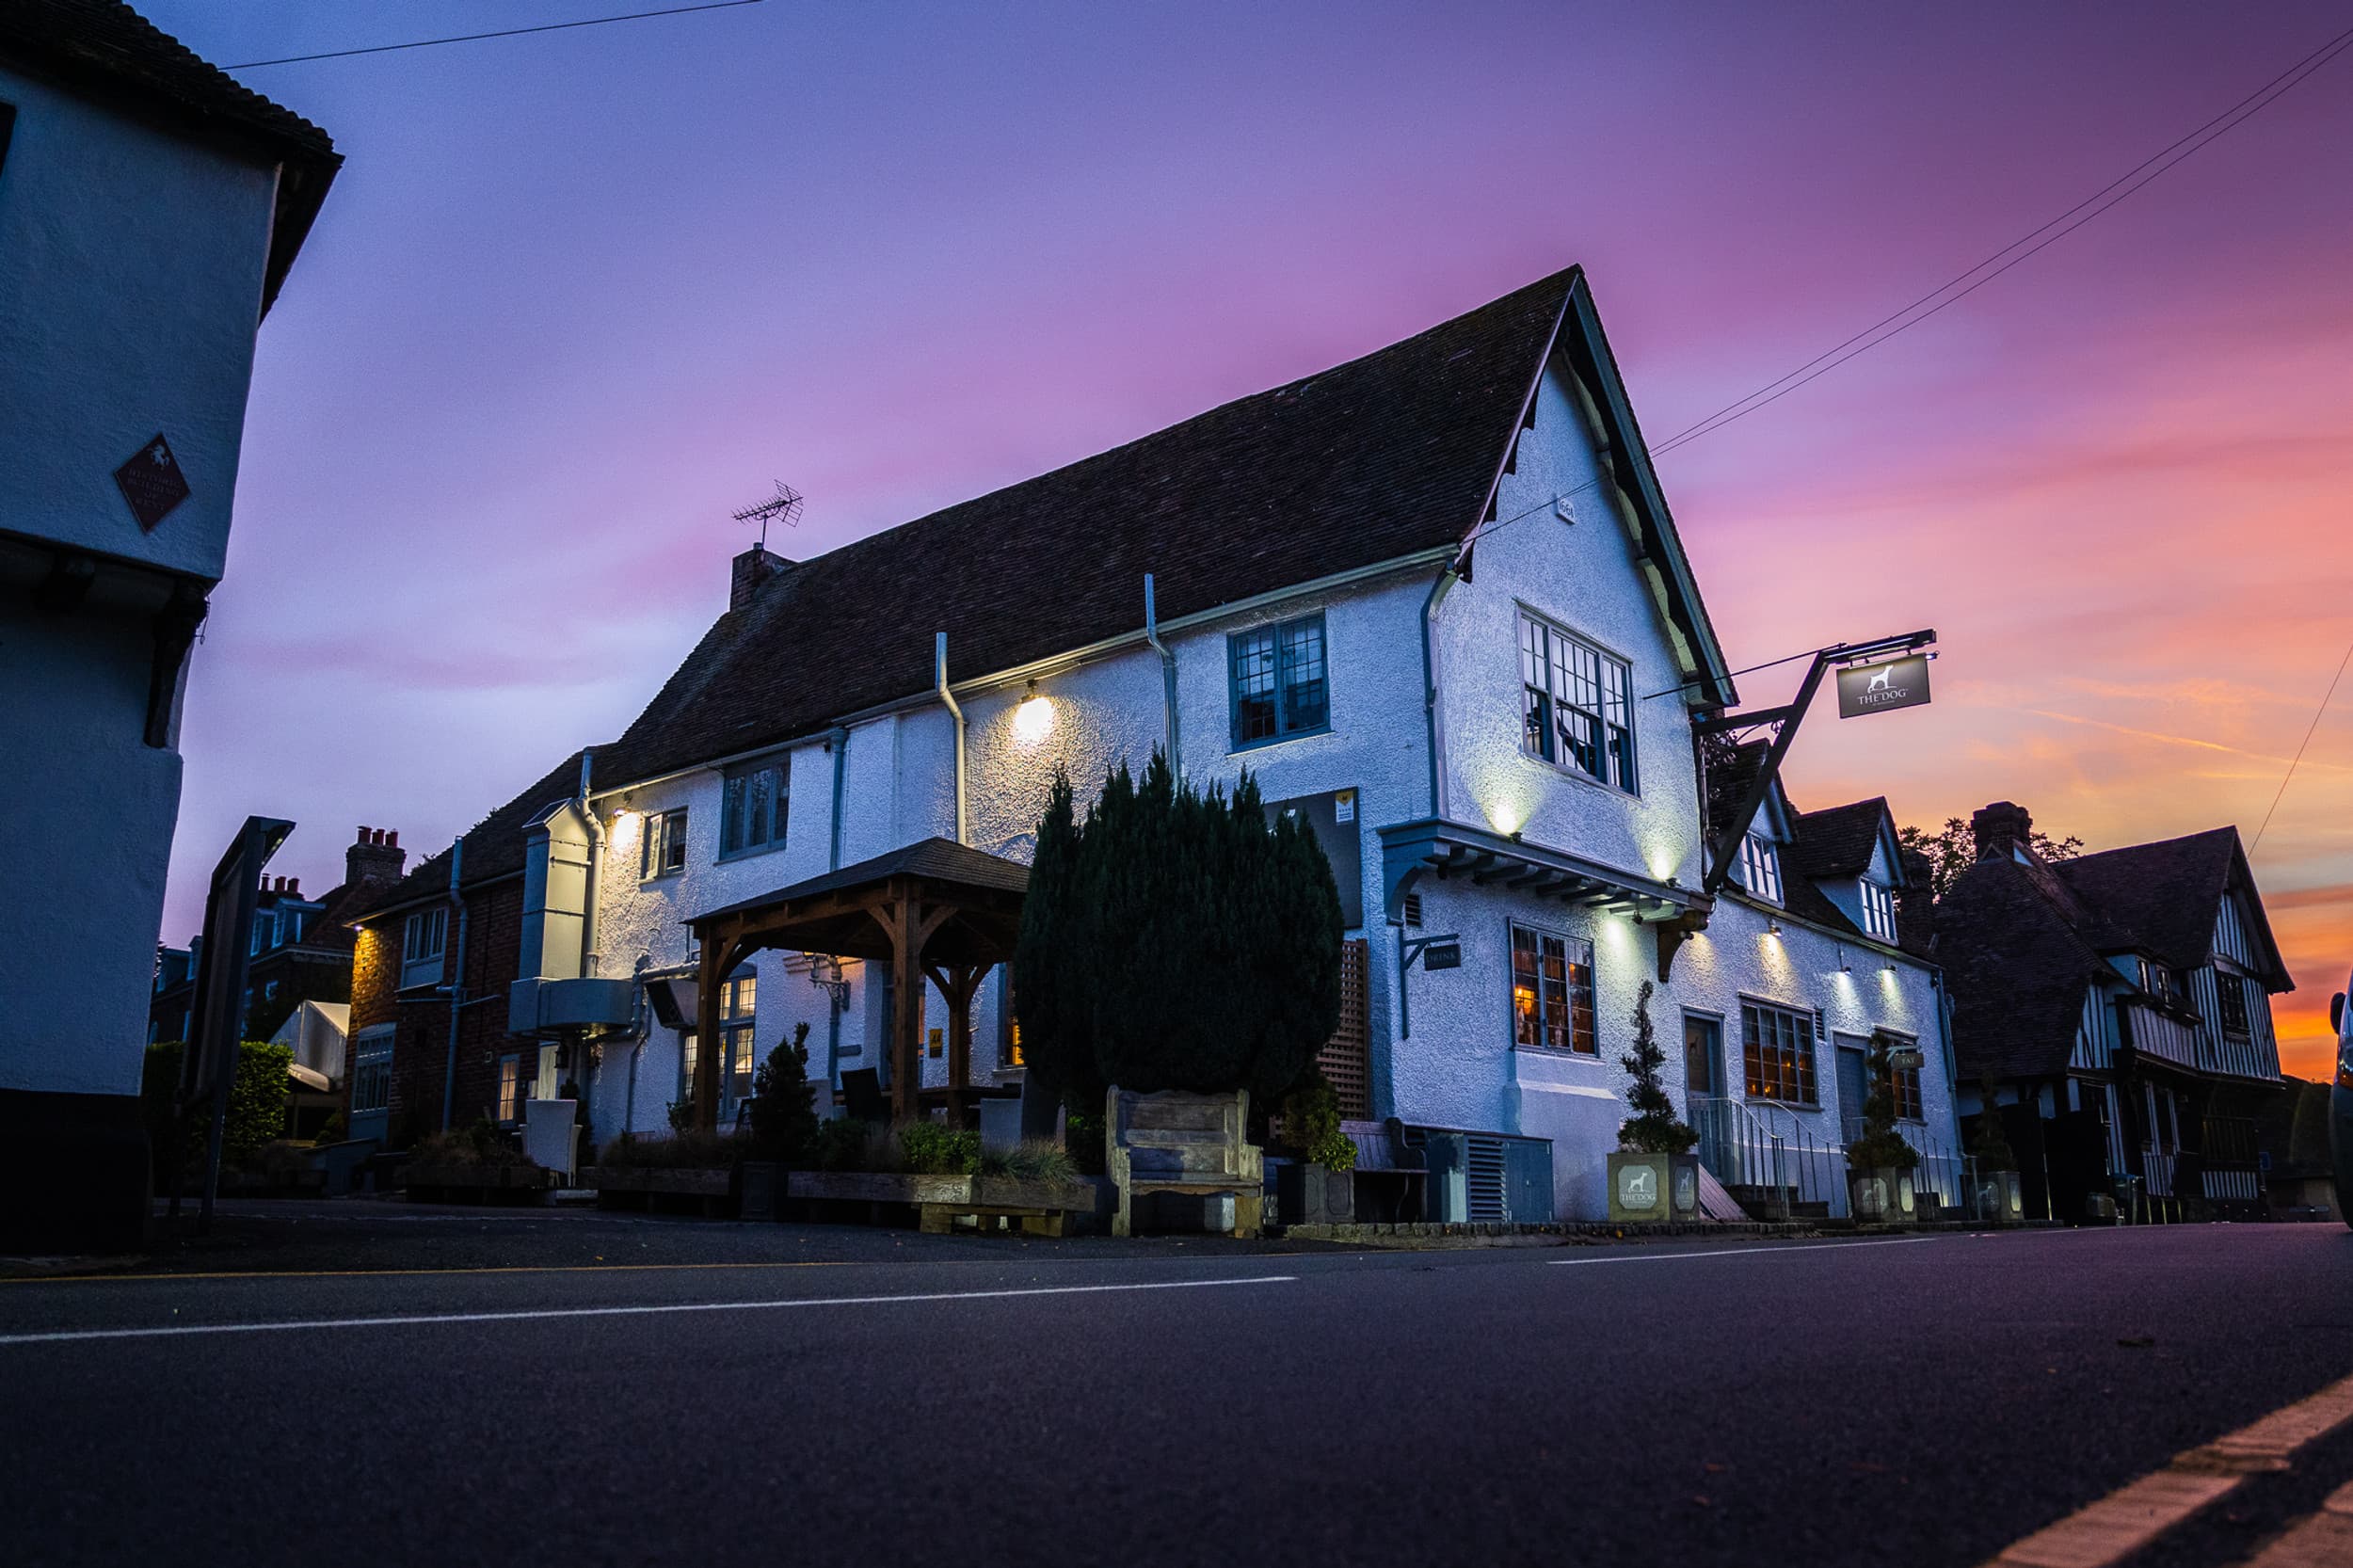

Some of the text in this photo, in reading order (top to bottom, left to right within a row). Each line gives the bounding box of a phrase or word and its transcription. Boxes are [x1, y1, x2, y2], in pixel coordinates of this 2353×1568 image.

[1857, 693, 1880, 705] THE
[1881, 688, 1906, 701] DOG
[1638, 1192, 1656, 1201] DOG
